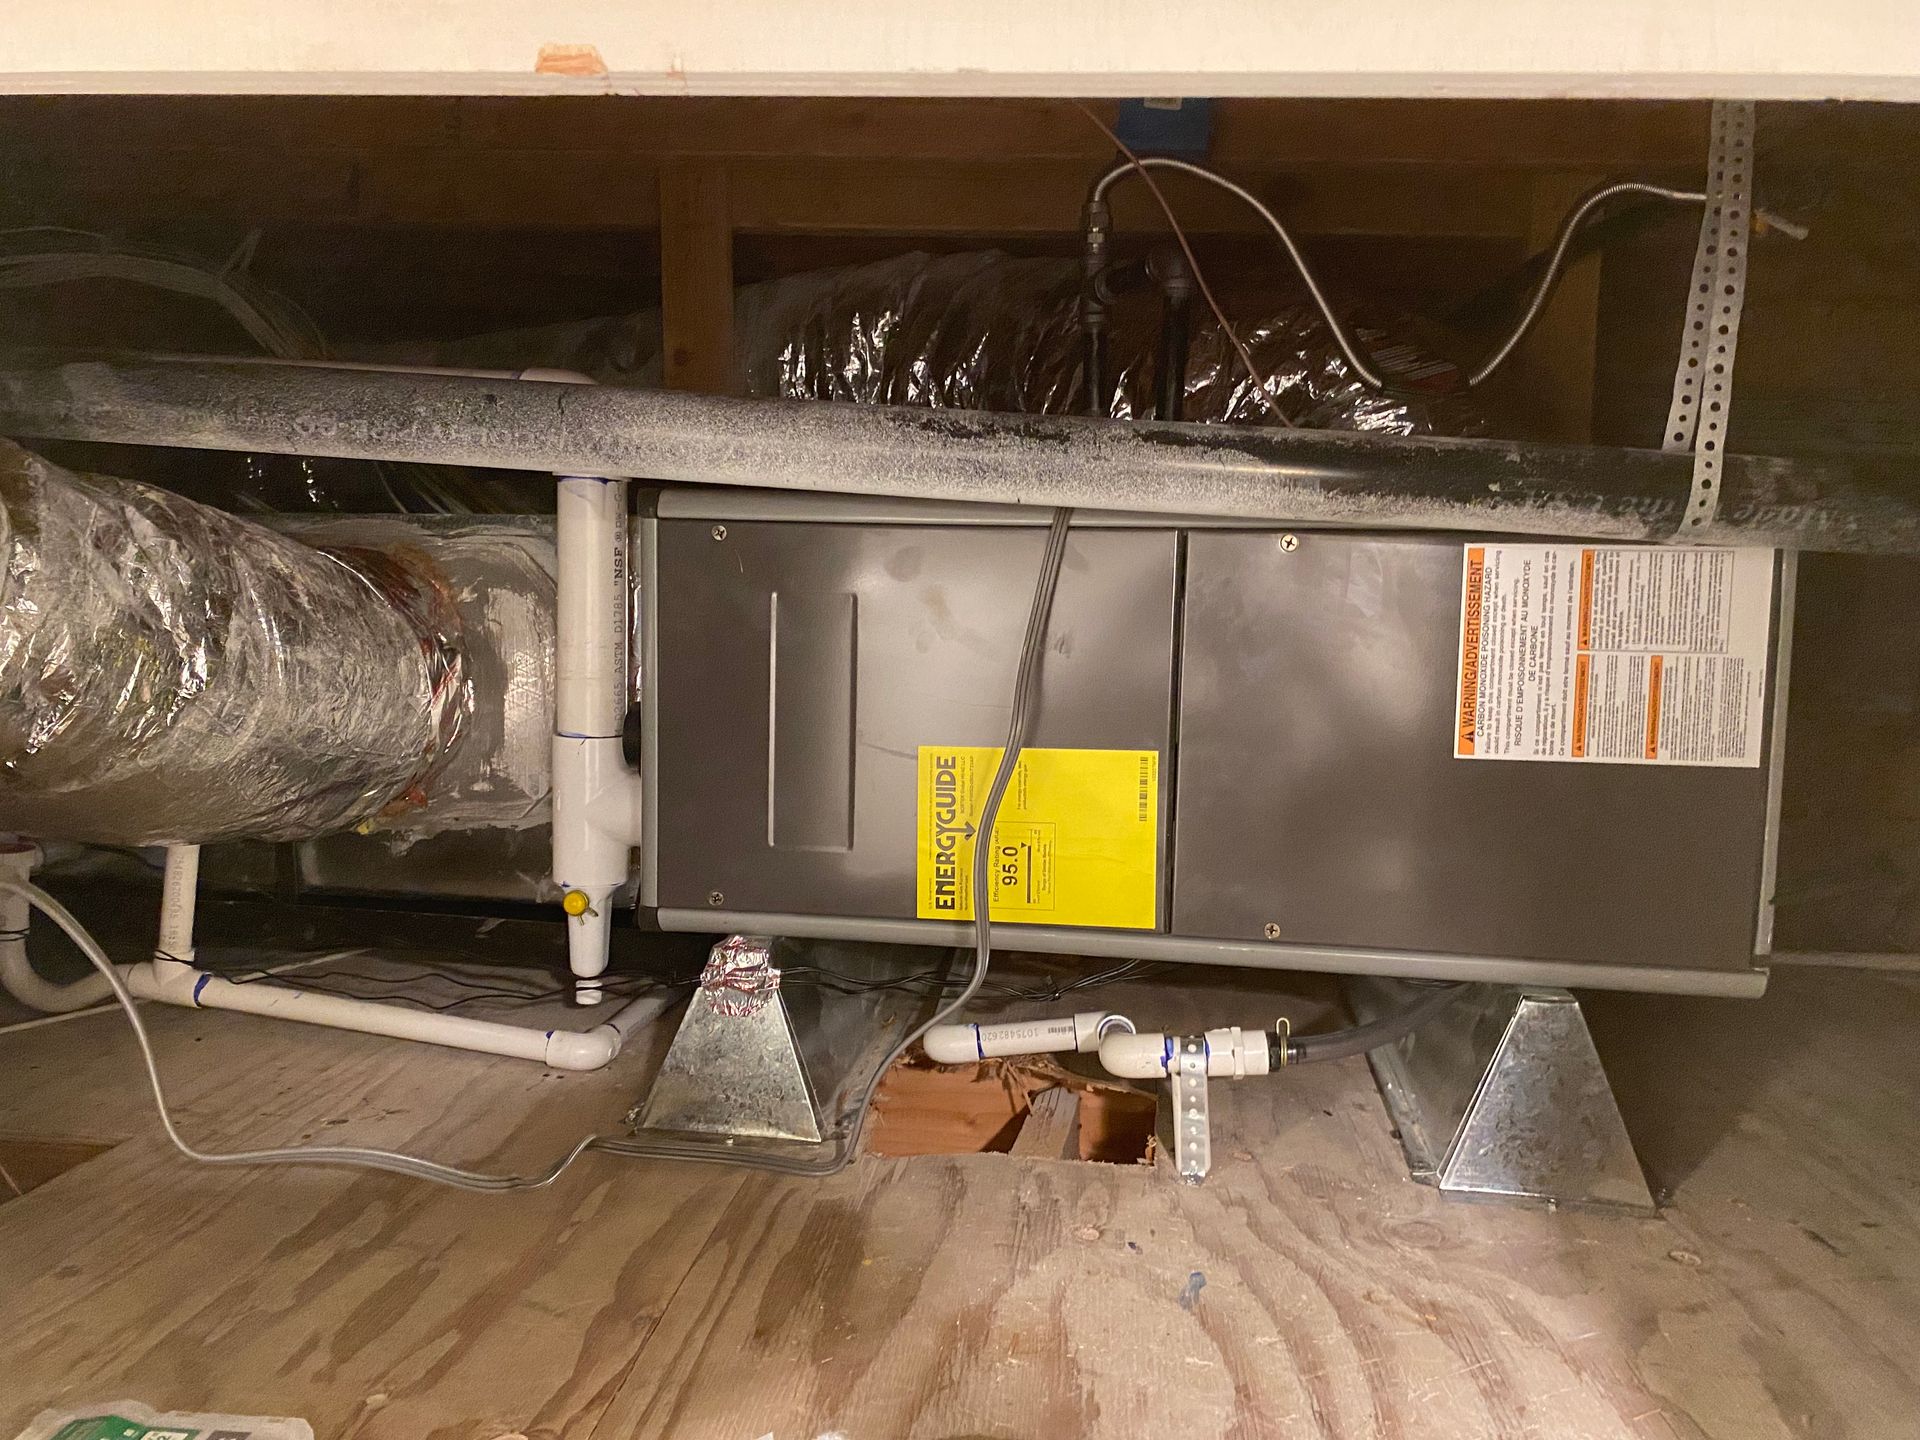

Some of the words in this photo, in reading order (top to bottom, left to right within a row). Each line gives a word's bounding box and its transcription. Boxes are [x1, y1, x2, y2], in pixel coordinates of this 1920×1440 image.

[1483, 567, 1492, 602] HAZARD
[1521, 559, 1531, 608] MONOXYDE
[613, 594, 624, 633] D1785
[1480, 604, 1490, 651] POISONING
[1520, 610, 1528, 621] AU
[1461, 559, 1482, 728] WARNING/ADVERTISSEMENT
[1498, 622, 1506, 653] poisoning
[1528, 625, 1538, 667] CARBONE
[613, 641, 624, 674] ASTM
[1478, 654, 1487, 698] MONOXIDE
[1488, 648, 1496, 689] compartment
[1507, 672, 1513, 680] be
[1515, 623, 1527, 712] D'EMPOISONNEMENT
[1528, 669, 1535, 681] DE
[613, 682, 624, 719] D2665
[1476, 701, 1485, 736] CARBON
[1504, 698, 1512, 739] compartment
[1534, 693, 1542, 736] compartiment
[1513, 714, 1522, 746] RISQUE
[1559, 702, 1567, 746] compartiment
[1558, 747, 1564, 755] Ce
[934, 755, 956, 910] ENERGYGUIDE
[1001, 846, 1018, 886] 95.0
[981, 1027, 1039, 1042] 1075482620
